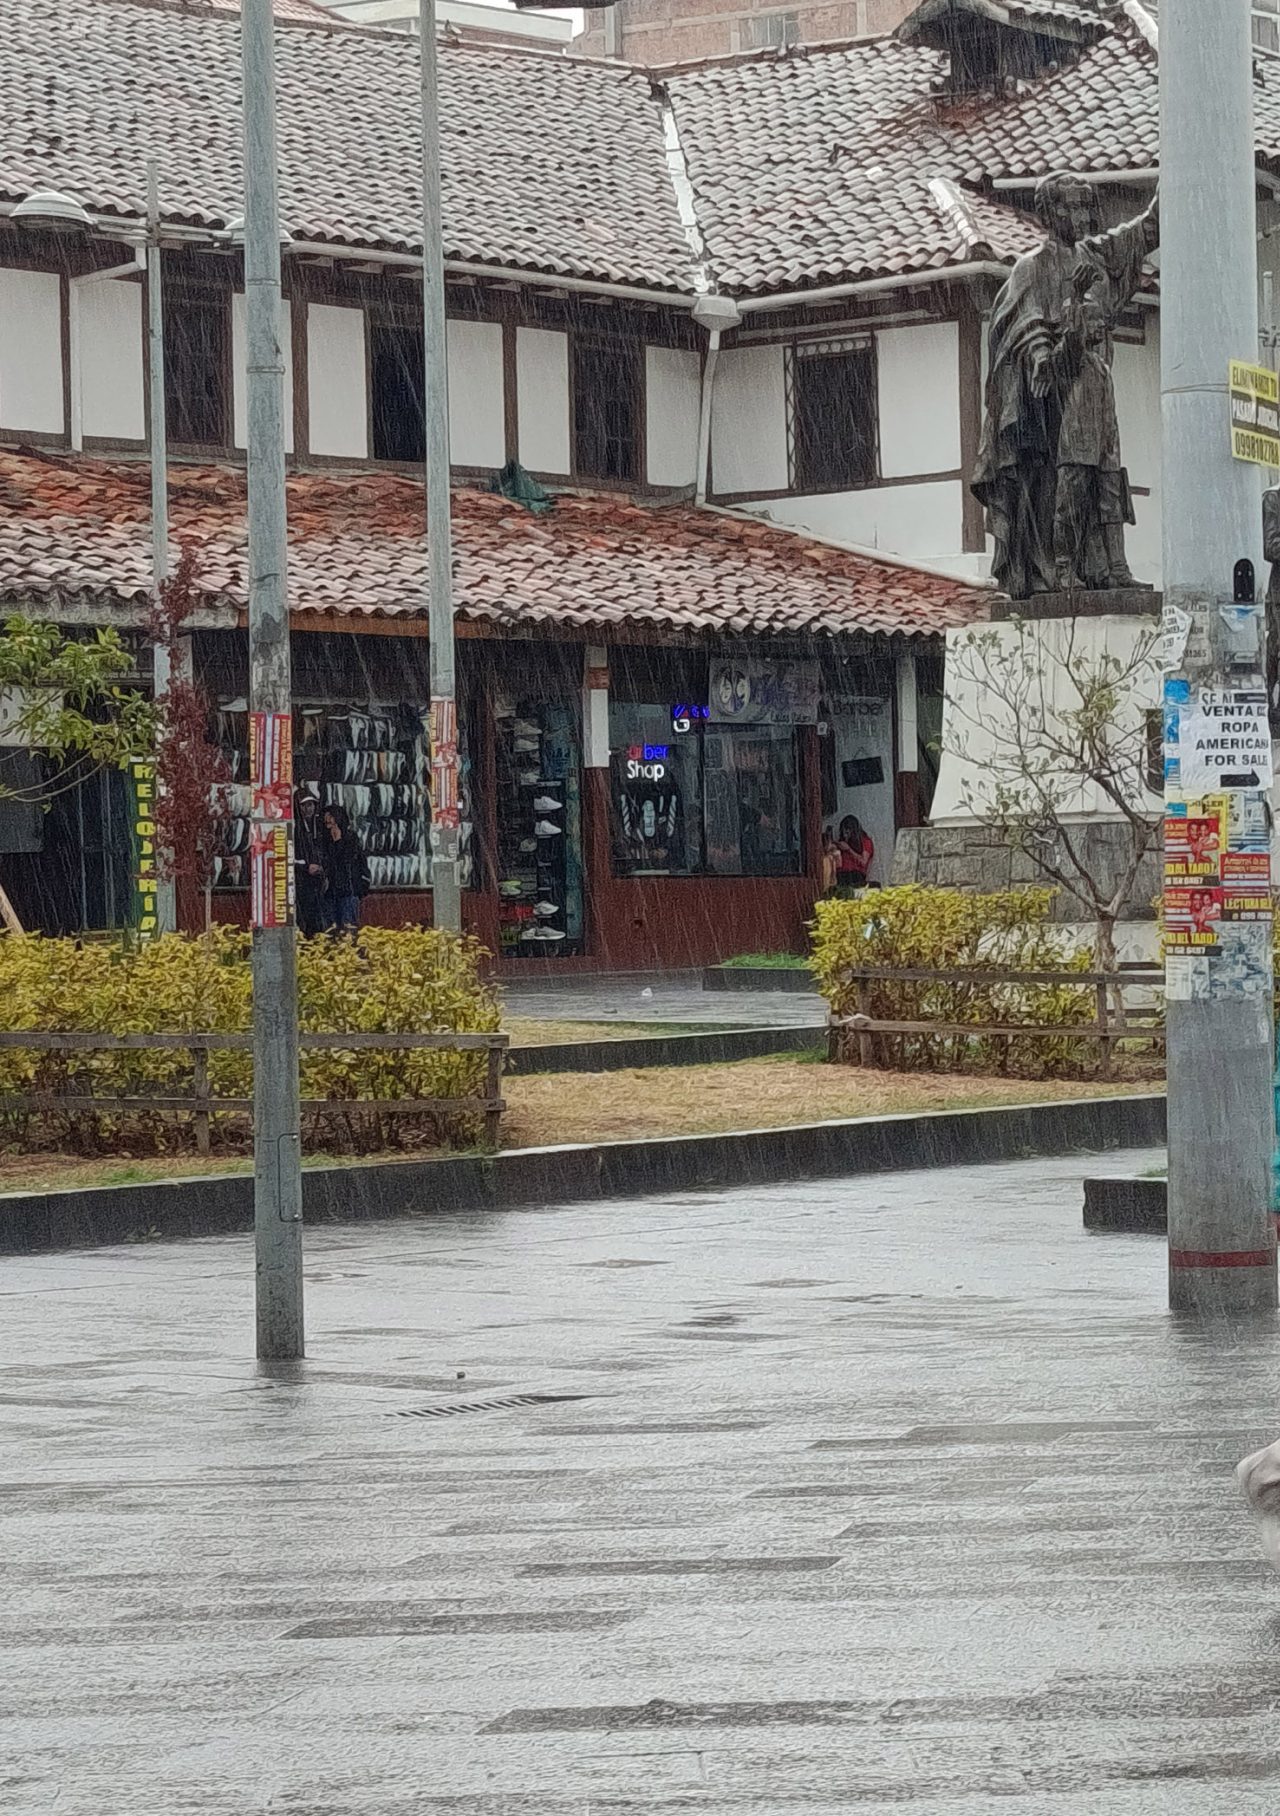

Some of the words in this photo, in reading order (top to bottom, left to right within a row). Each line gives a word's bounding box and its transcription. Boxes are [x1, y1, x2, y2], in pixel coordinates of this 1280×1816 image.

[1202, 706, 1253, 717] VENTA
[1221, 722, 1259, 733] ROPA
[1205, 754, 1236, 766] FOR
[1242, 754, 1268, 766] SALE
[626, 760, 665, 782] Shop
[274, 826, 287, 857] TAROT
[274, 860, 287, 878] DEL
[274, 879, 287, 923] LECTURA
